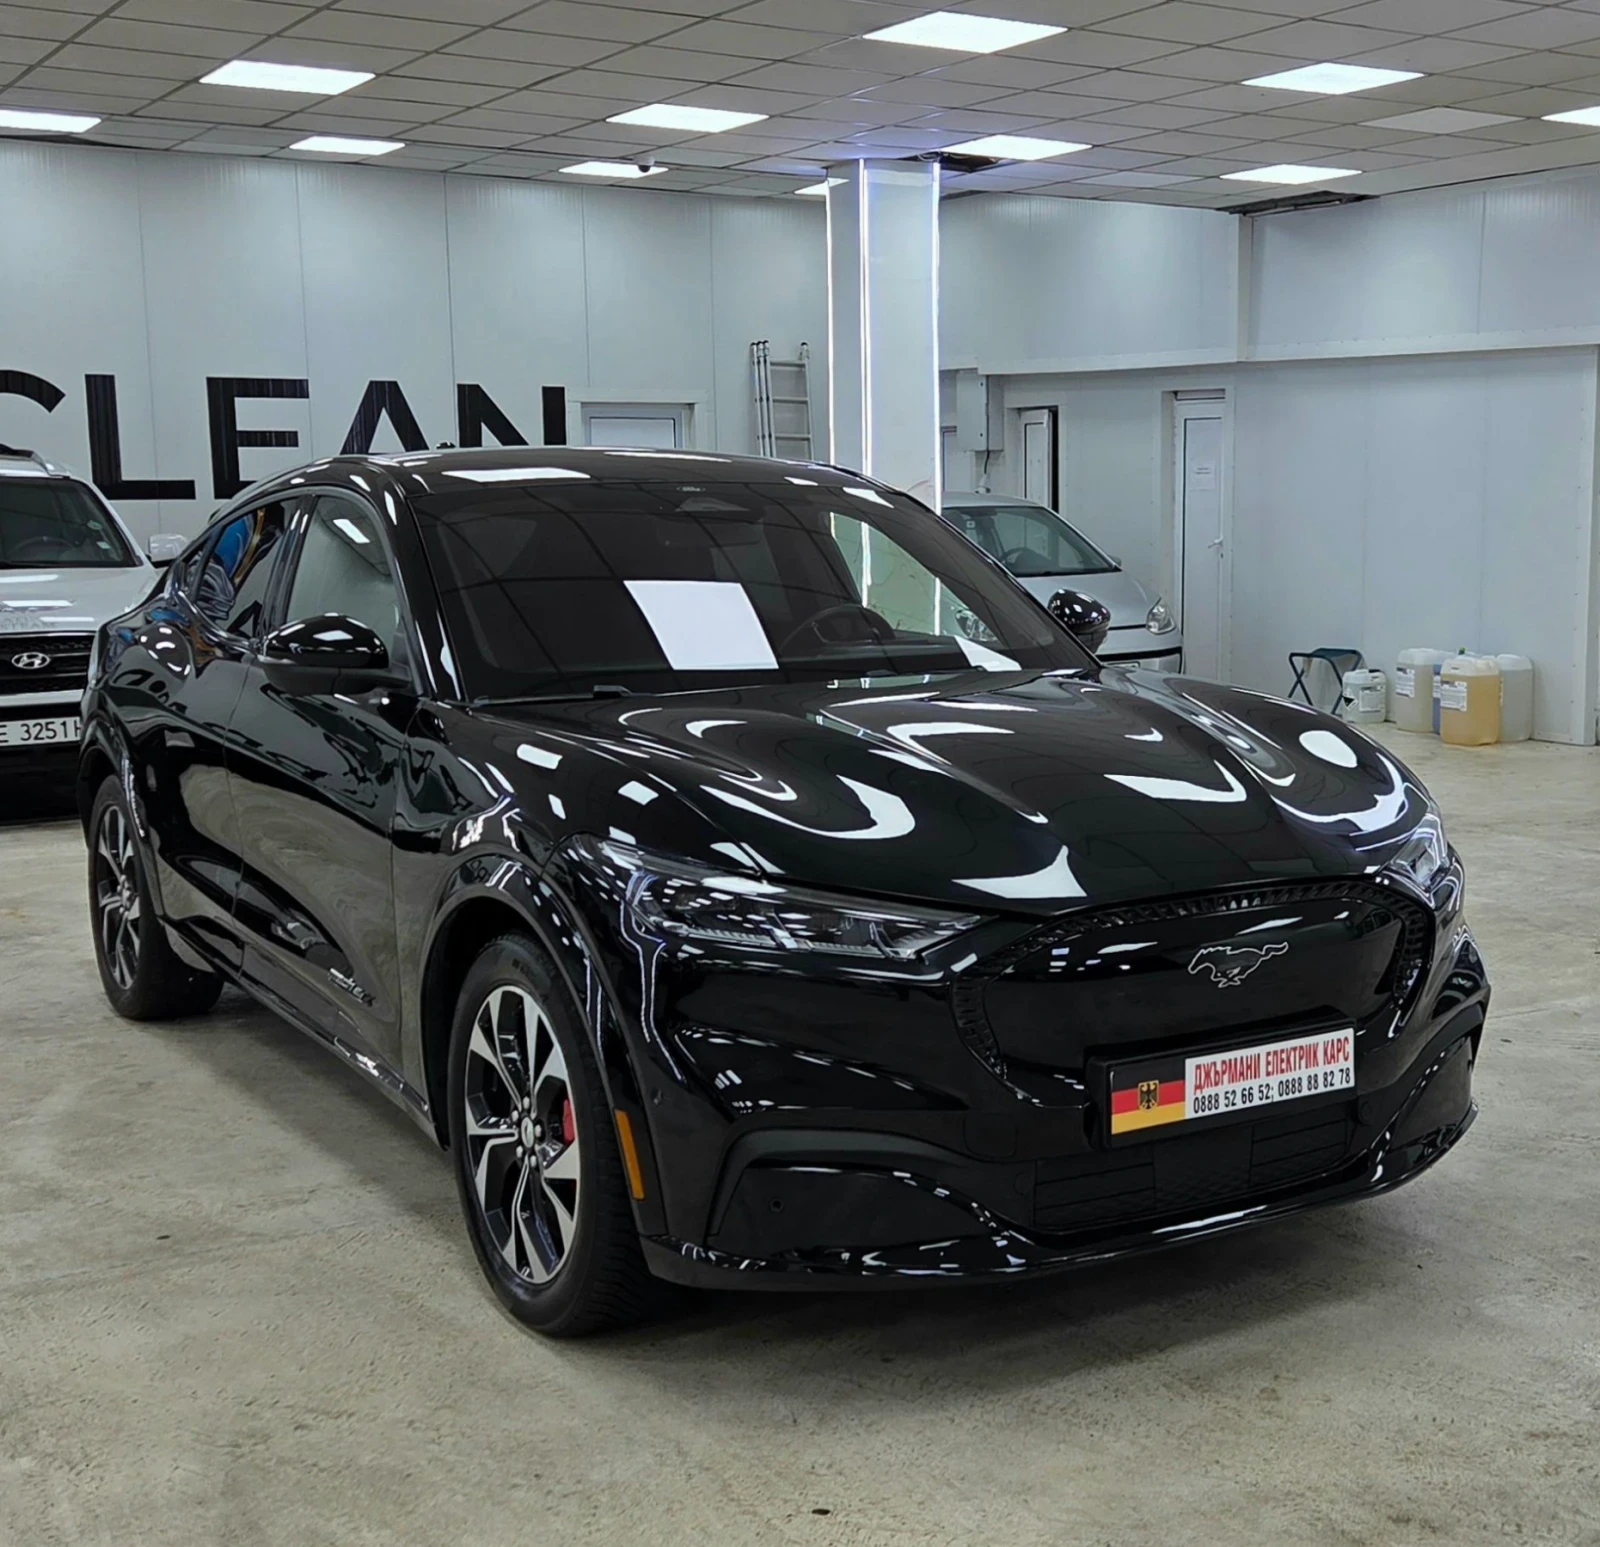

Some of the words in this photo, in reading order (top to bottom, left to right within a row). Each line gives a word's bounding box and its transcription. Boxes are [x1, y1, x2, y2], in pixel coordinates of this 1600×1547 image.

[20, 720, 68, 741] 3251
[1194, 1053, 1261, 1096] ДЖЪРМАНИ
[1266, 1042, 1319, 1077] ЕЛЕКТРИК
[1323, 1036, 1350, 1066] КАРС
[1193, 1093, 1220, 1114] 0888
[1224, 1090, 1237, 1108] 52
[1241, 1086, 1254, 1105] 66
[1258, 1083, 1274, 1103] 52;
[1278, 1077, 1303, 1097] 0888
[1307, 1073, 1319, 1091] 88
[1323, 1070, 1335, 1088] 82
[1339, 1067, 1351, 1085] 78
